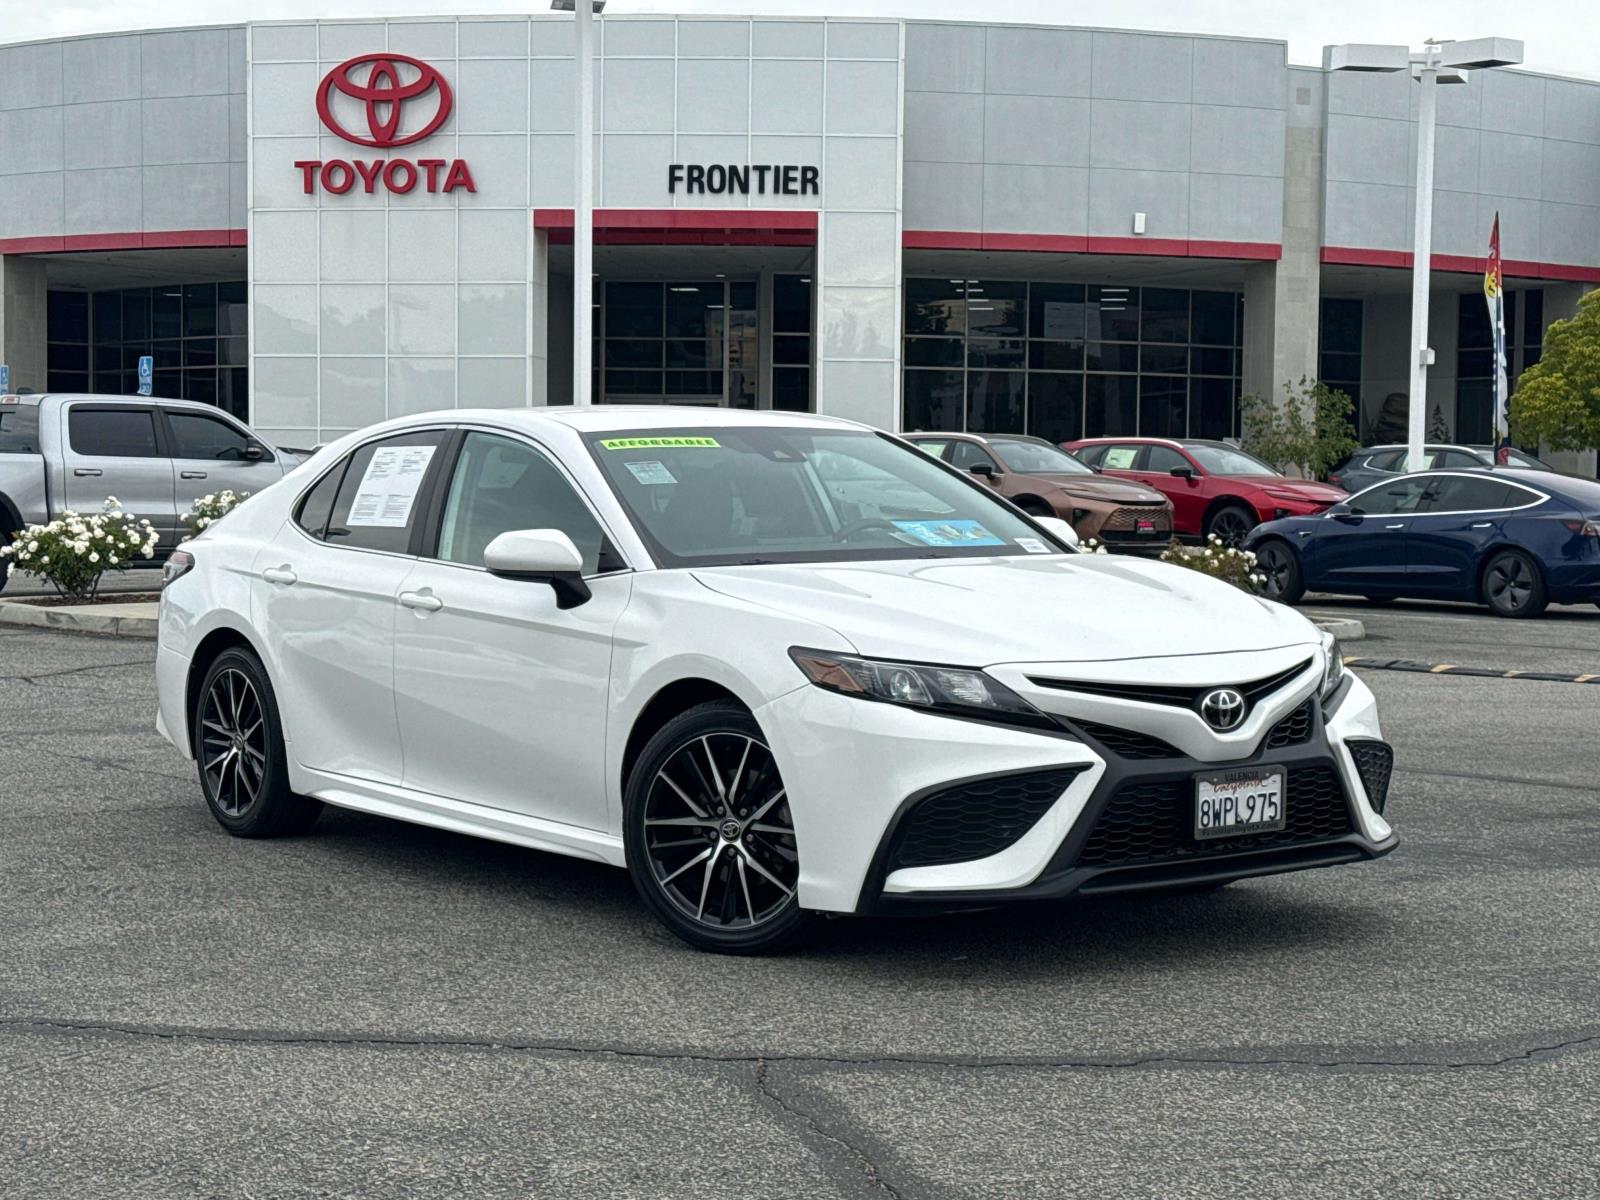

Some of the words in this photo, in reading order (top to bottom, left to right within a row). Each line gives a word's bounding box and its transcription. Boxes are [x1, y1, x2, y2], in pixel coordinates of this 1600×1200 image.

[294, 159, 477, 195] TOYOTA
[668, 164, 819, 195] FRONTIER
[607, 439, 715, 448] AFFORDABLE
[1224, 771, 1259, 782] VALENCIA
[1201, 793, 1278, 827] 8WPL975
